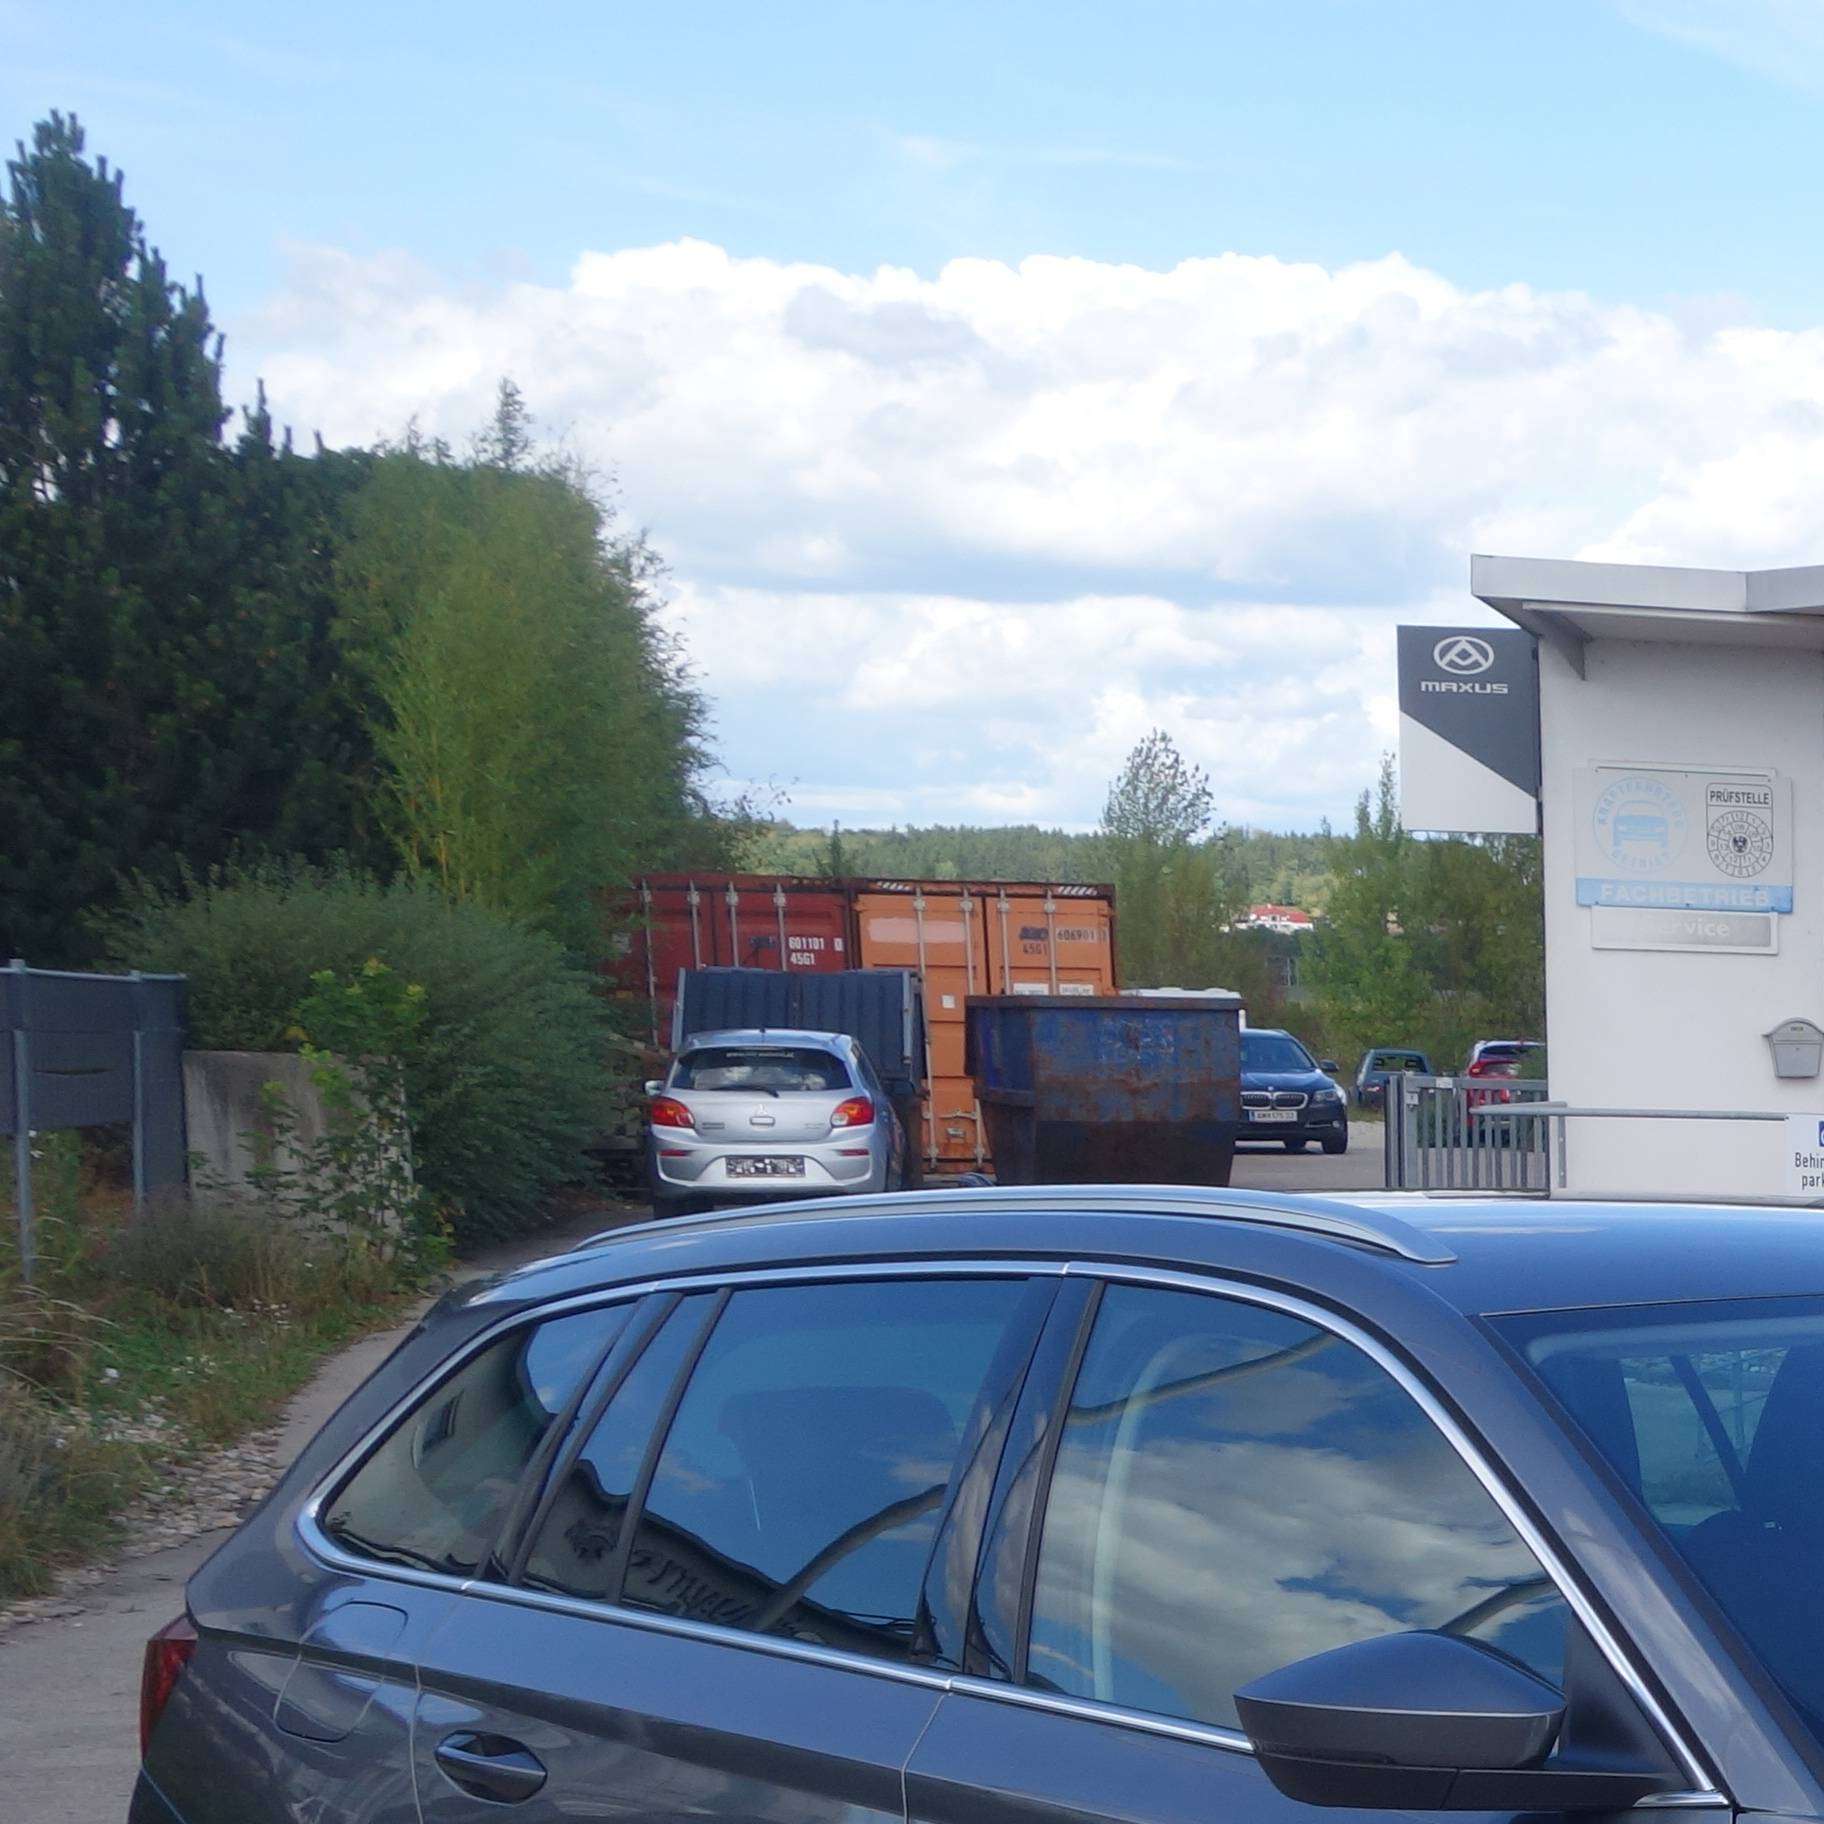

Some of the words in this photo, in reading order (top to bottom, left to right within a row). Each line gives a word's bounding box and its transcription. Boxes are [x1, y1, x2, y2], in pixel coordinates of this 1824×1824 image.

[1420, 680, 1509, 694] MAXUS
[1709, 788, 1770, 805] PRÜFSTELLE
[1601, 883, 1770, 906] FACHBETRIEB
